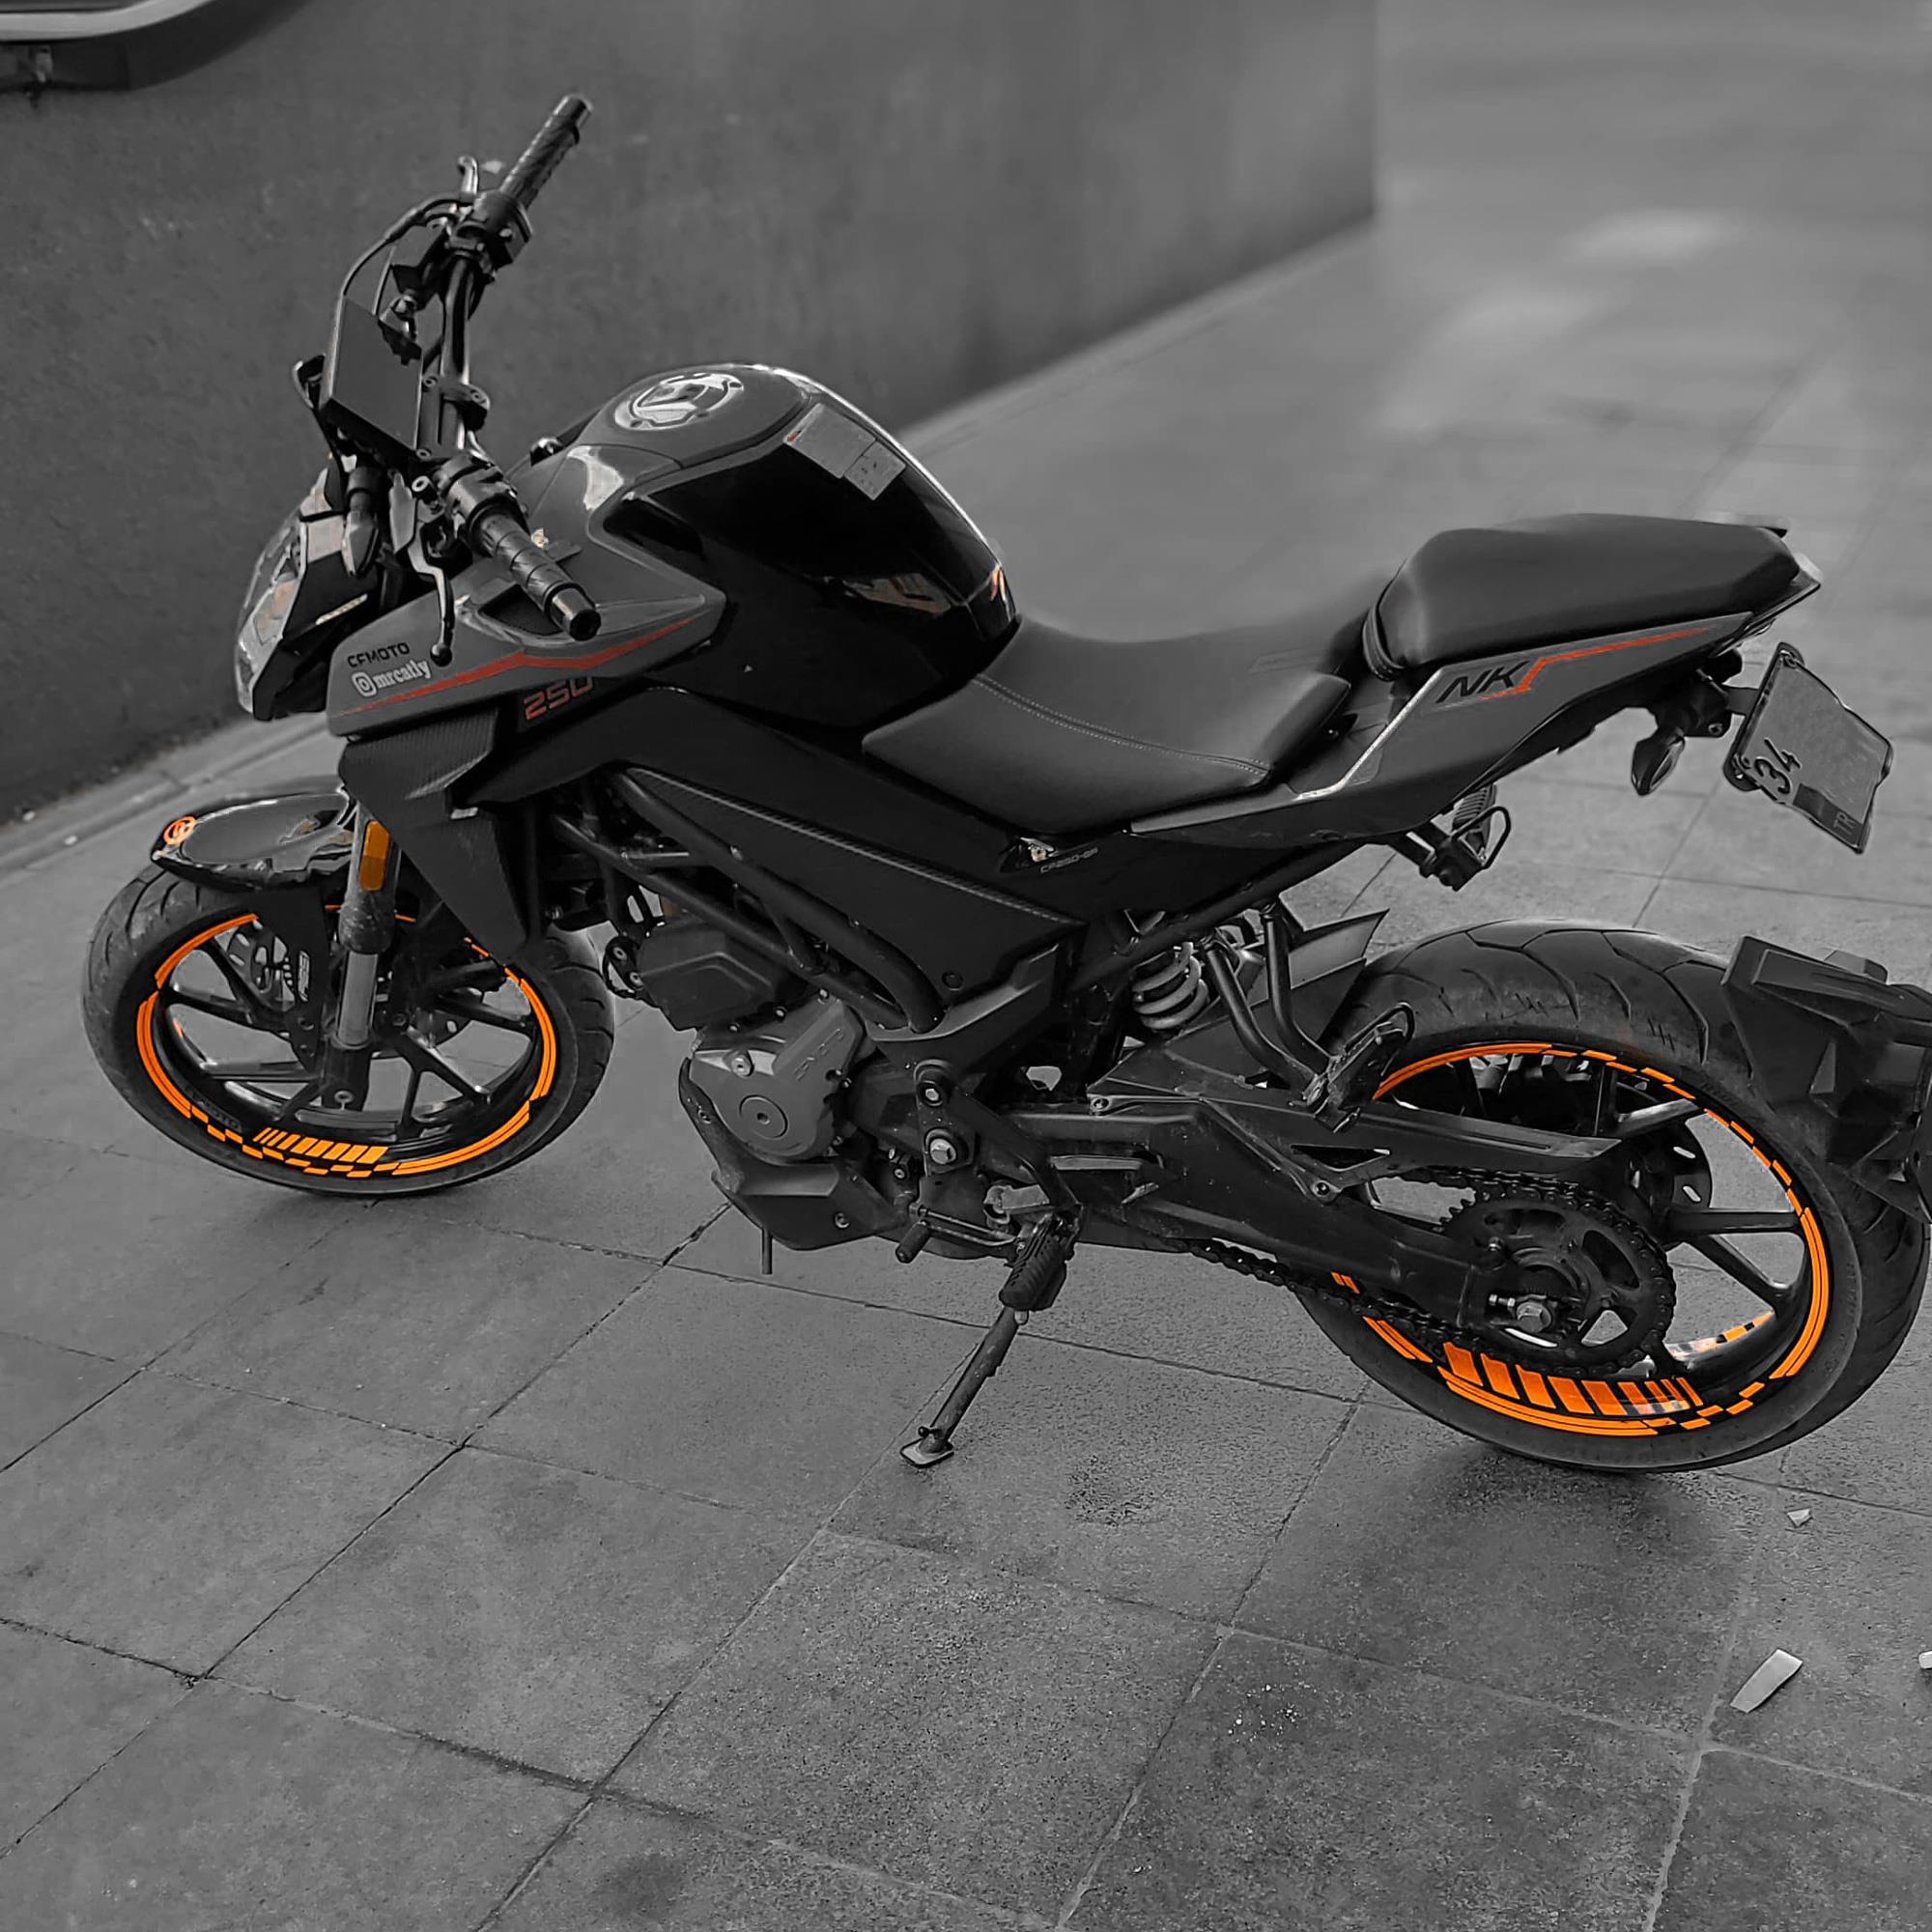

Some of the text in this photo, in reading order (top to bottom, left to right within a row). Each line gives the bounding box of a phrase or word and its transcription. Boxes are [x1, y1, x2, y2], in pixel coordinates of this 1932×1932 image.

[347, 641, 411, 668] CFMOTO
[523, 675, 594, 721] 250
[1435, 660, 1531, 704] NK
[1753, 737, 1802, 795] 34
[1833, 812, 1856, 837] TR
